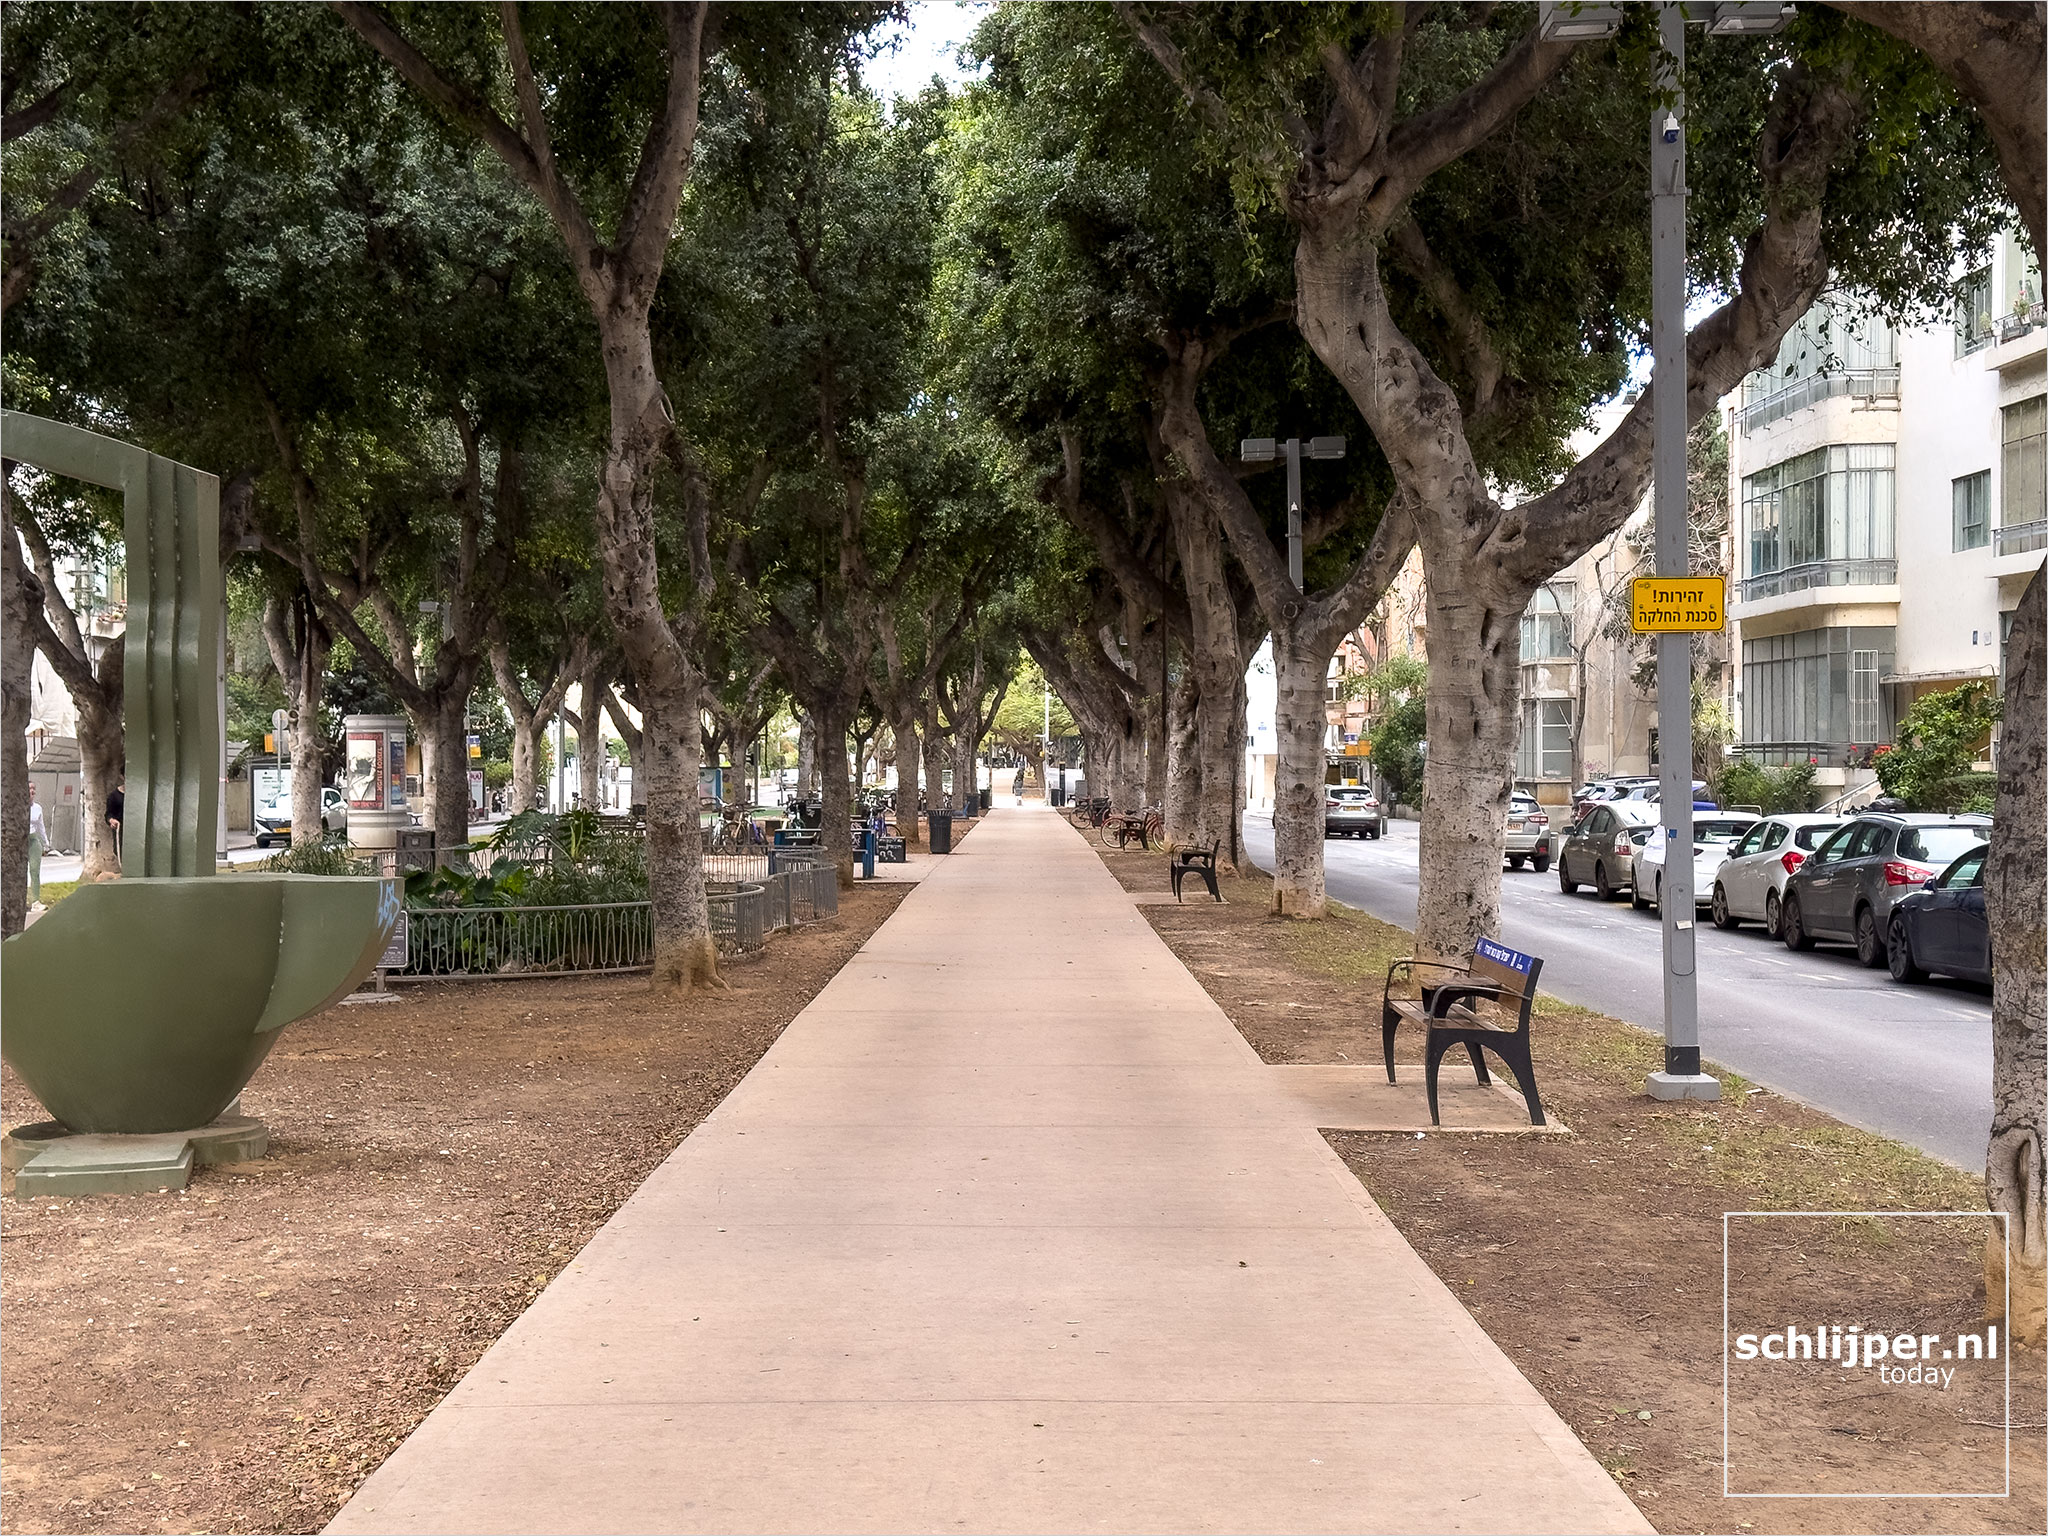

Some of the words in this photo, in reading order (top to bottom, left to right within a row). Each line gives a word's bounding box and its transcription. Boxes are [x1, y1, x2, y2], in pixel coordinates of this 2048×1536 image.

[1653, 589, 1704, 603] זהירות!
[1639, 607, 1681, 626] החלקה
[1685, 610, 1717, 623] סכנת
